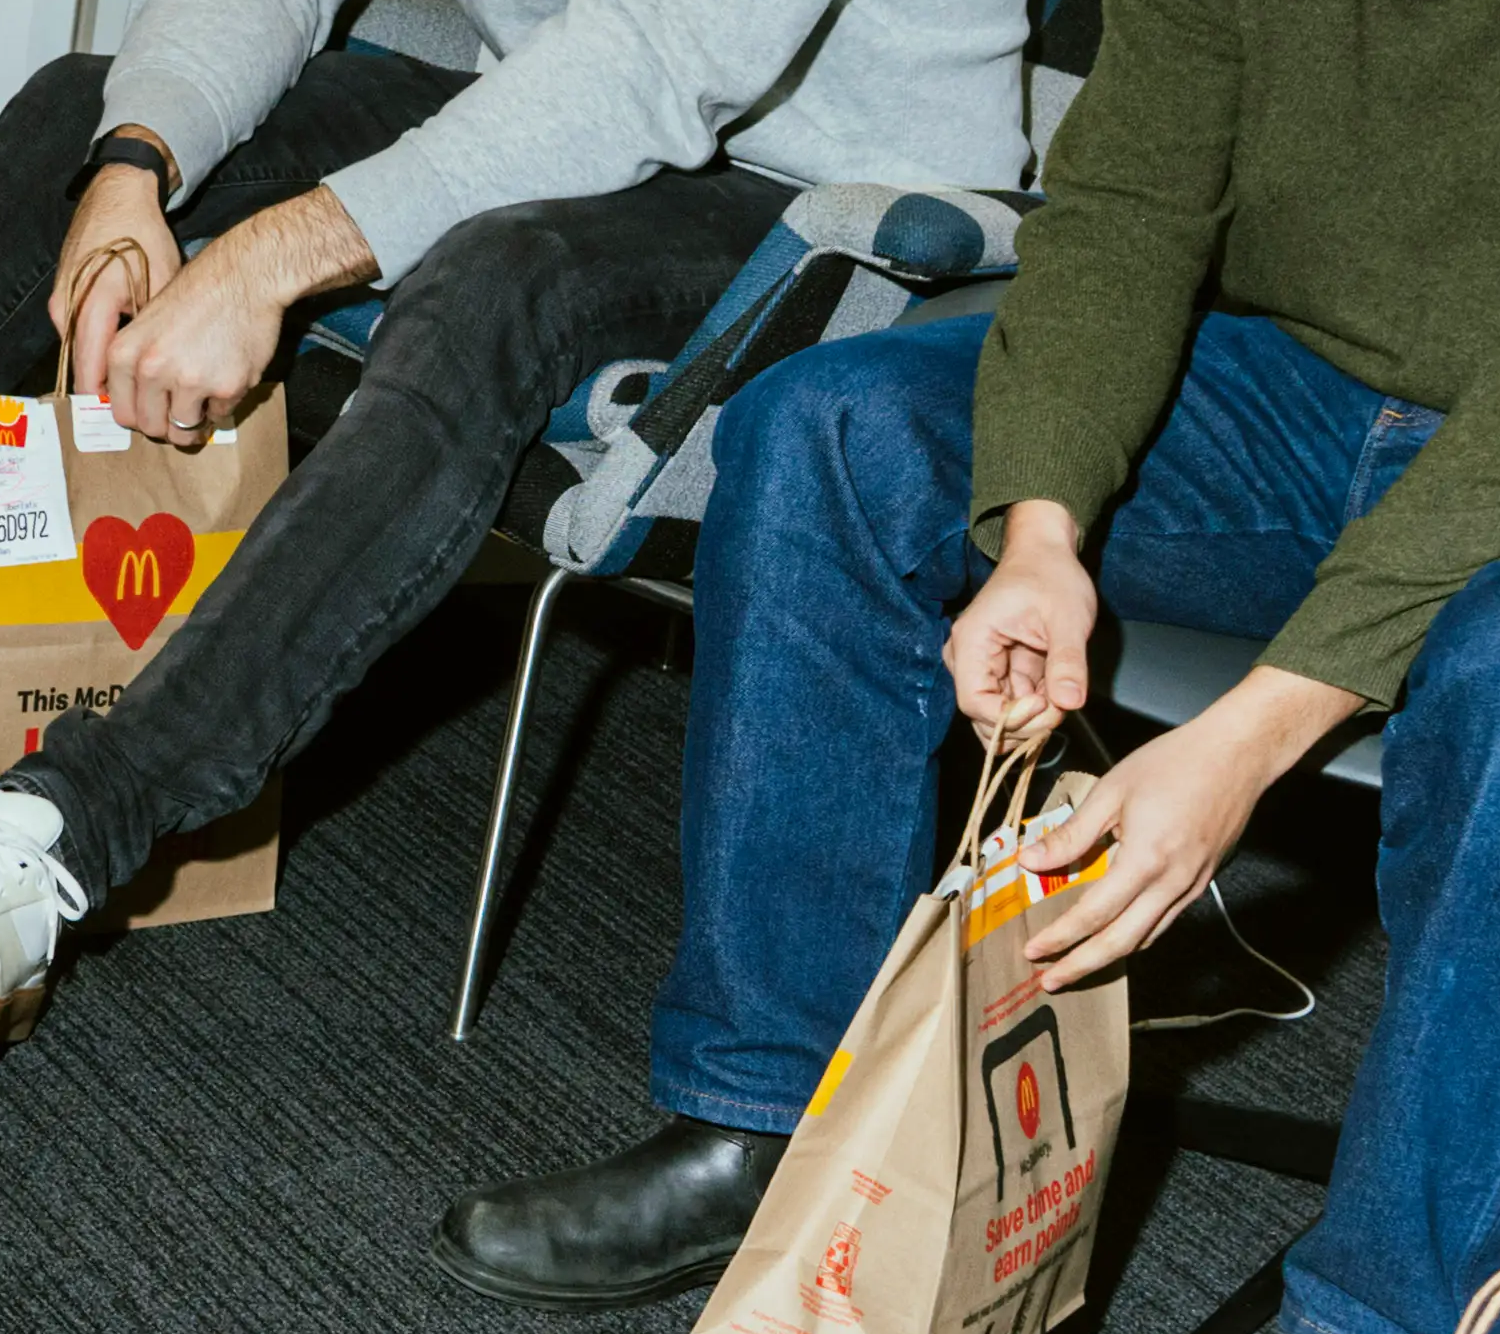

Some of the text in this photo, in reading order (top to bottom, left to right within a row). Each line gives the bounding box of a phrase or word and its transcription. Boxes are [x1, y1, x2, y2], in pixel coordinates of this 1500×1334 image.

[18, 687, 70, 712] This
[985, 1148, 1095, 1253] Save time and
[993, 1239, 1032, 1284] earn
